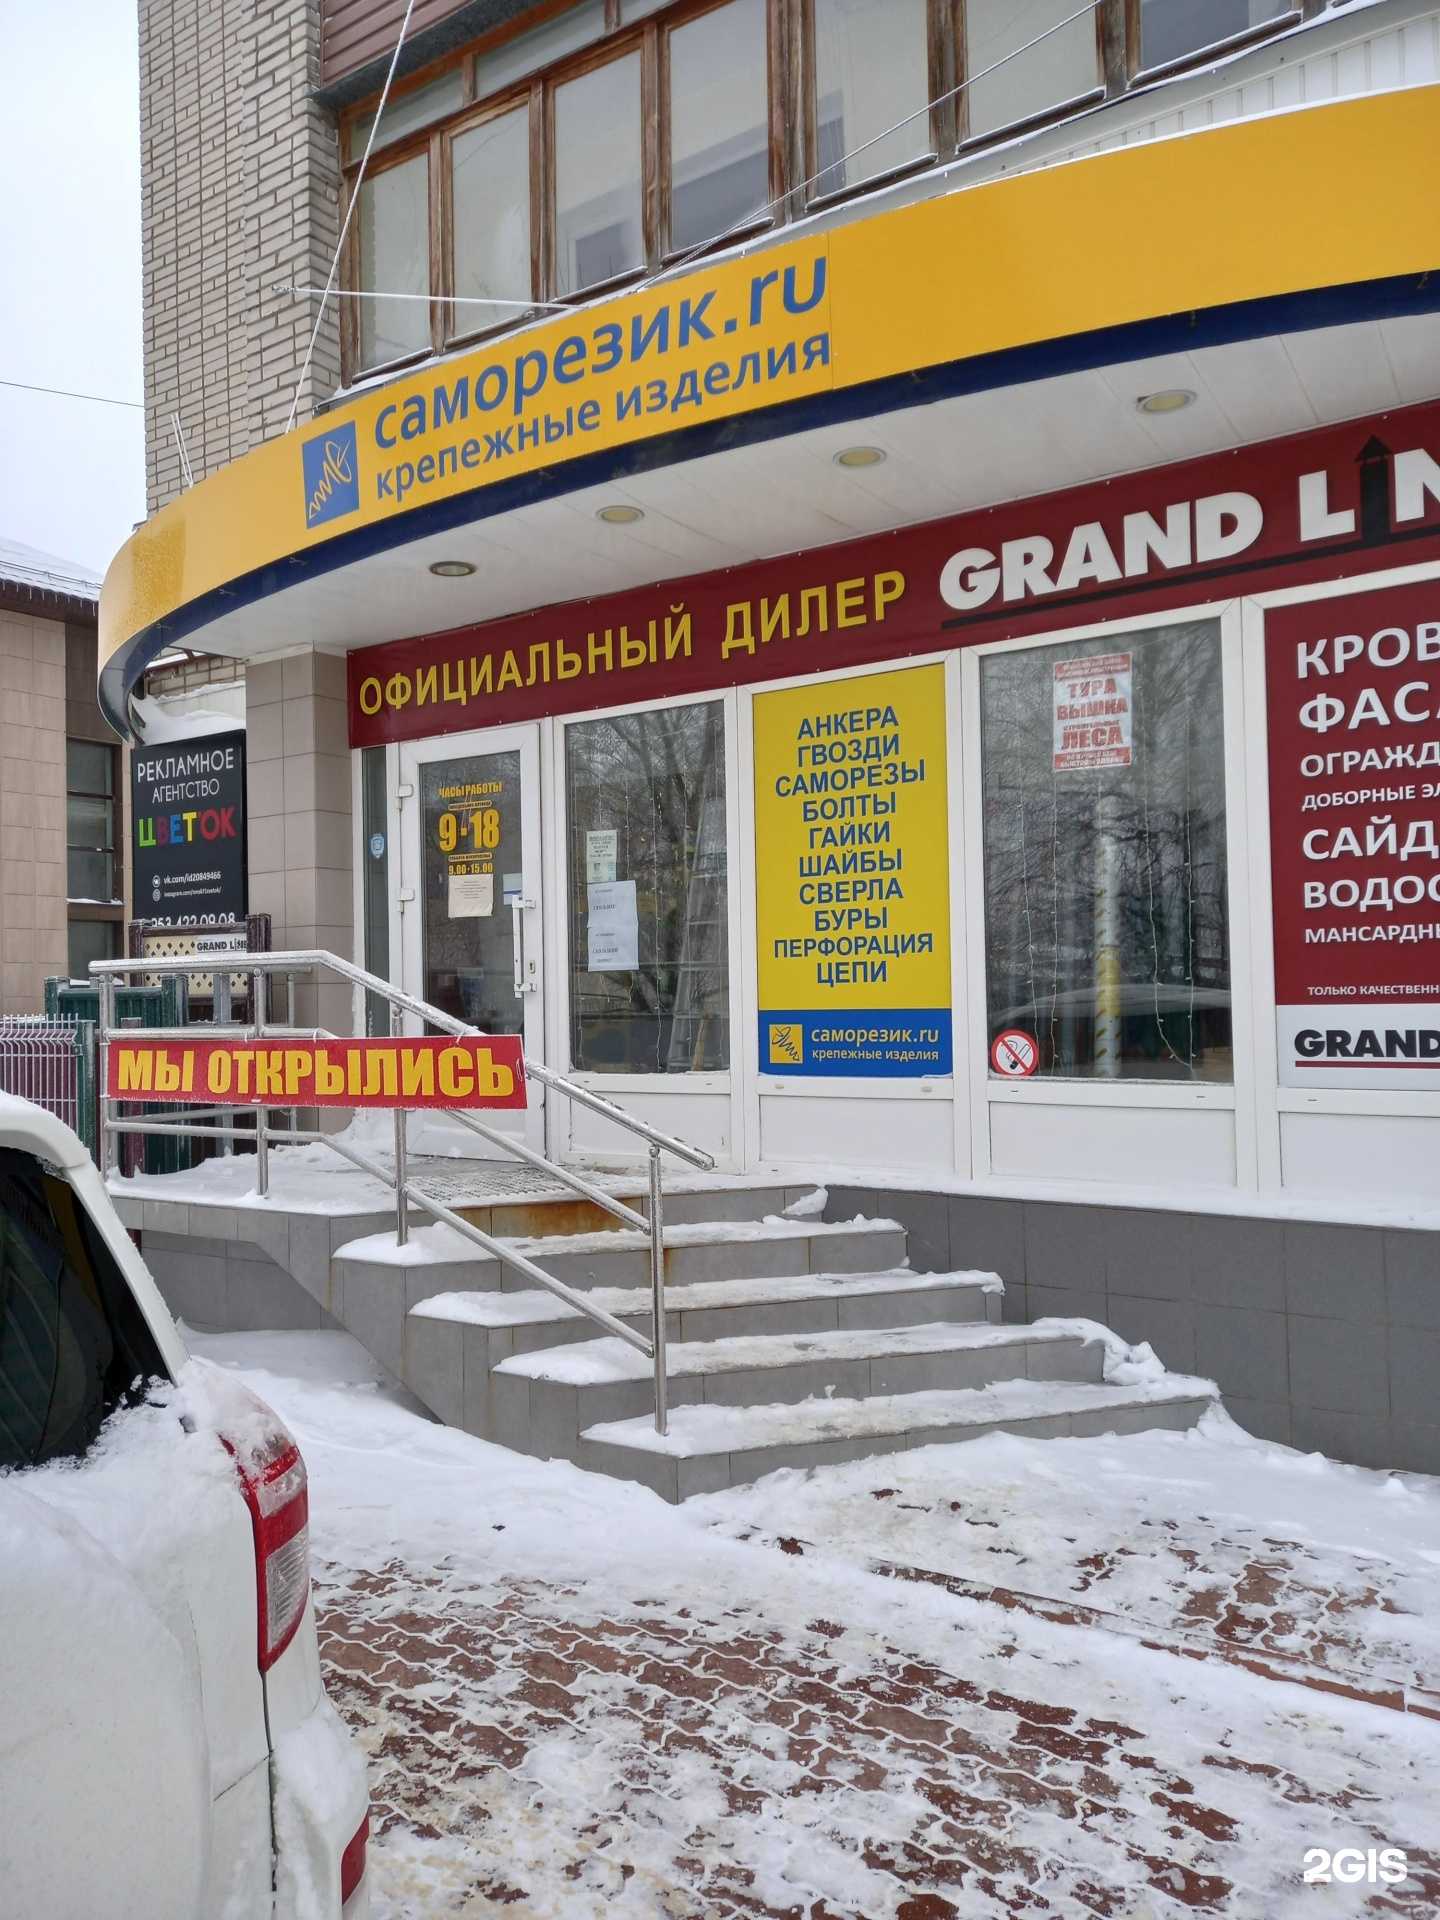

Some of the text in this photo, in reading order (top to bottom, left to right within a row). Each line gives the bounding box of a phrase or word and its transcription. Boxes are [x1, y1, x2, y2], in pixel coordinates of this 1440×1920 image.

[374, 257, 828, 450] саморезик.ru
[376, 332, 830, 502] крепежные изделия
[940, 492, 1263, 610] GRAND
[359, 569, 907, 715] ОФИЦИАЛЬНЫЙ ДИЛЕР
[1297, 622, 1440, 679] КРОВ
[1057, 697, 1128, 720] ВЫШКА
[1299, 681, 1440, 733] ФАС
[797, 705, 899, 740] АНКЕРА
[798, 733, 900, 768] ГВОЗДИ
[1061, 726, 1123, 750] ЛЕСА
[137, 748, 234, 783] РЕКЛАМНОЕ
[1300, 741, 1440, 777] ОГРАЖД
[152, 778, 220, 804] АГЕНТСТВО
[438, 782, 503, 798] ЧАСЫ РАБОТЫ
[775, 759, 925, 798] САМОРЕЗЫ
[803, 792, 896, 823] БОЛТЫ
[1301, 785, 1416, 812] ДОБОРНЫЕ
[138, 807, 237, 847] ЦВЕТОК
[809, 821, 890, 849] ГАЙКИ
[1302, 814, 1440, 861] САЙД
[799, 848, 902, 878] ШАЙБЫ
[799, 878, 904, 905] СВЕРЛА
[814, 907, 888, 932] БУРЫ
[1305, 923, 1440, 944] МАНСАРДН
[196, 941, 227, 951] GRAND
[774, 933, 933, 958] ПЕРФОРАЦИЯ
[816, 961, 887, 988] ЦЕПИ
[1307, 986, 1358, 996] ТОЛЬКО
[811, 1028, 939, 1046] саморезик.ru
[1294, 1028, 1440, 1058] GRAND
[812, 1048, 939, 1063] крепежные изделия
[118, 1048, 515, 1097] МЫ ОТКРЫЛИСЬ
